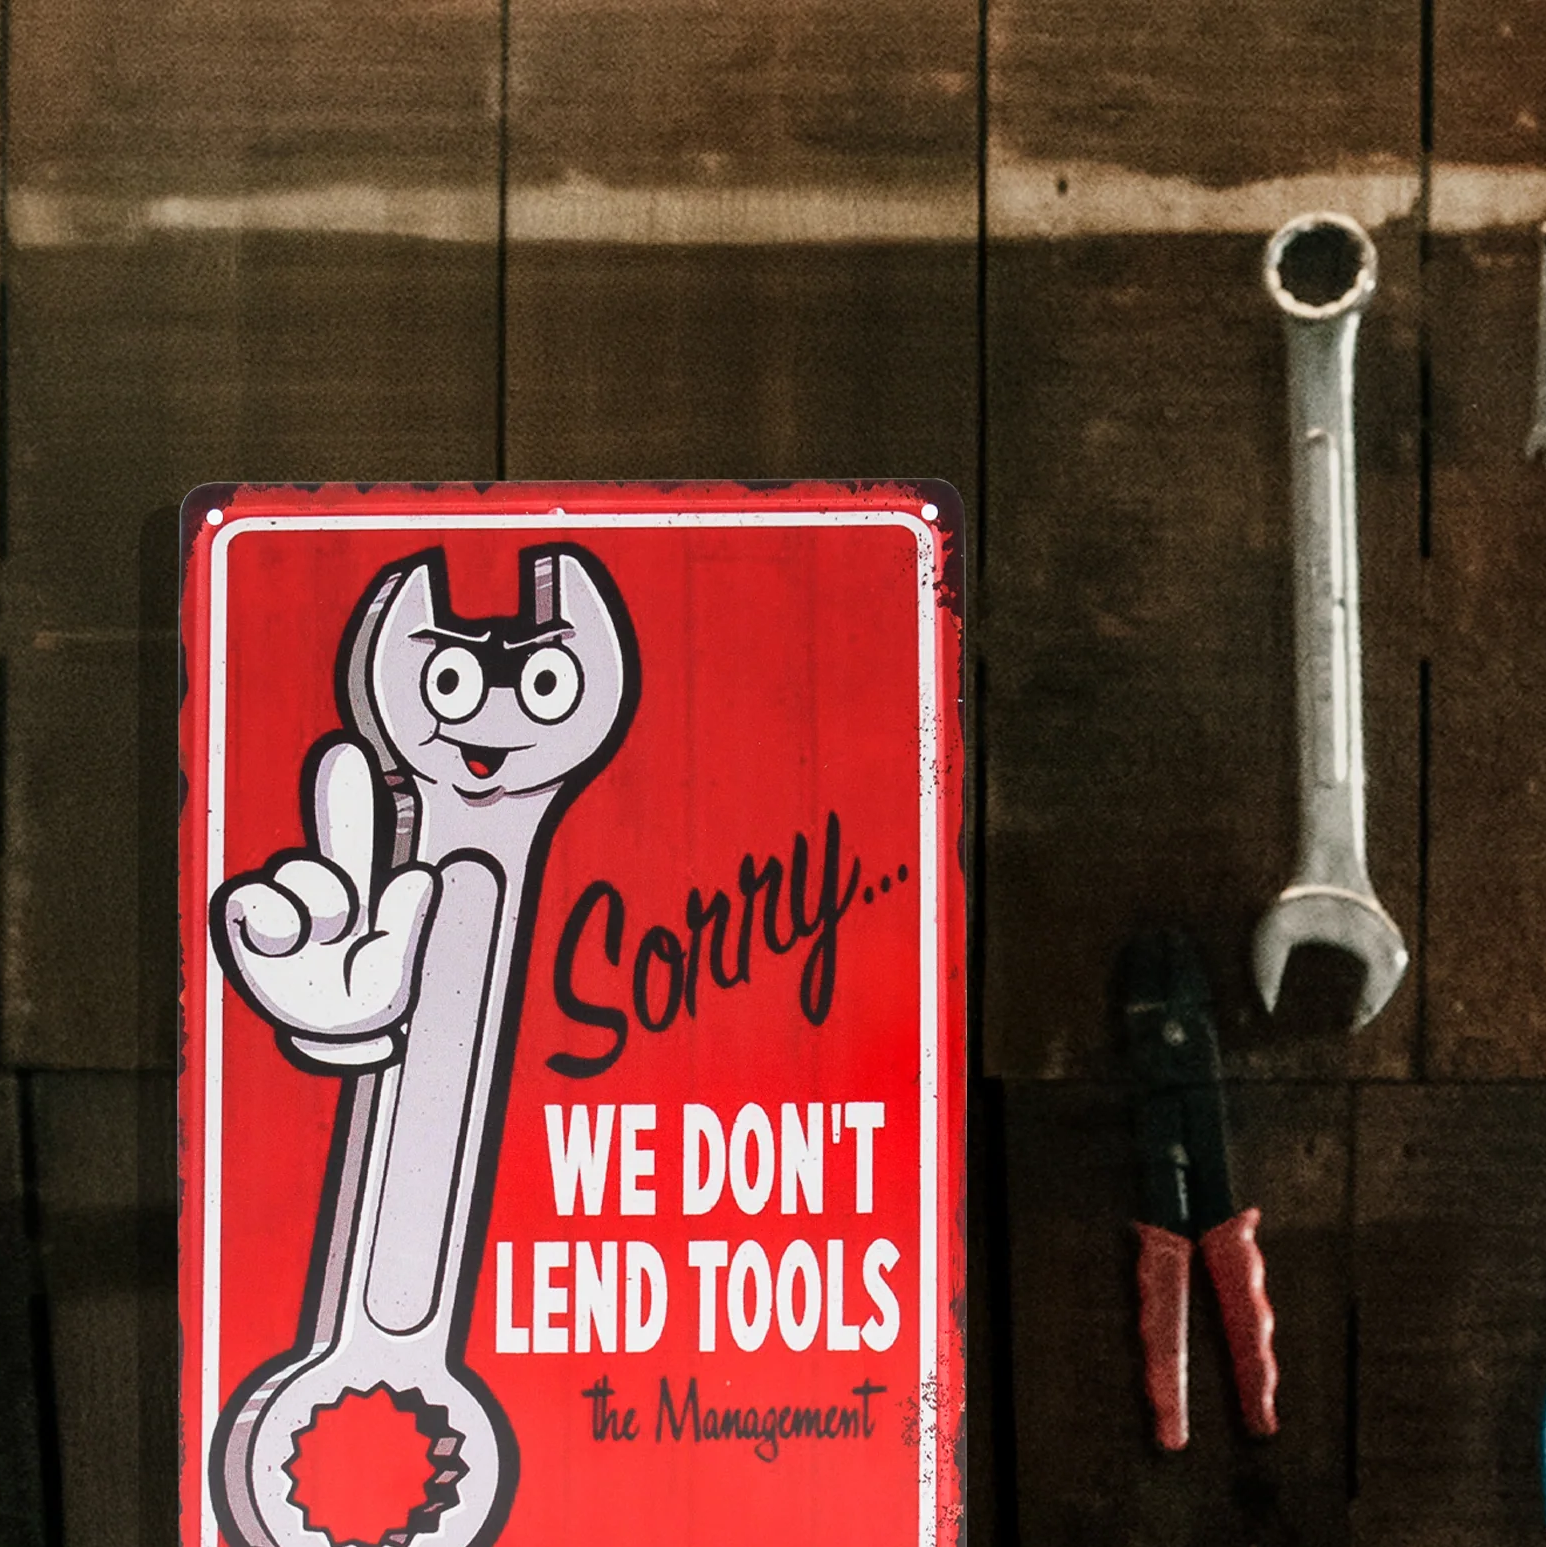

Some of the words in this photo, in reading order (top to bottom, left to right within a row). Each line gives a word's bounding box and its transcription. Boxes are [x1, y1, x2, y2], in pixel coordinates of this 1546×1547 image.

[544, 809, 910, 1080] Sorry...
[543, 1102, 657, 1217] WE
[682, 1101, 885, 1217] DON'T
[495, 1240, 668, 1354] LEND
[688, 1237, 901, 1354] TOOLS
[581, 1374, 637, 1443] the
[653, 1374, 887, 1462] Management
